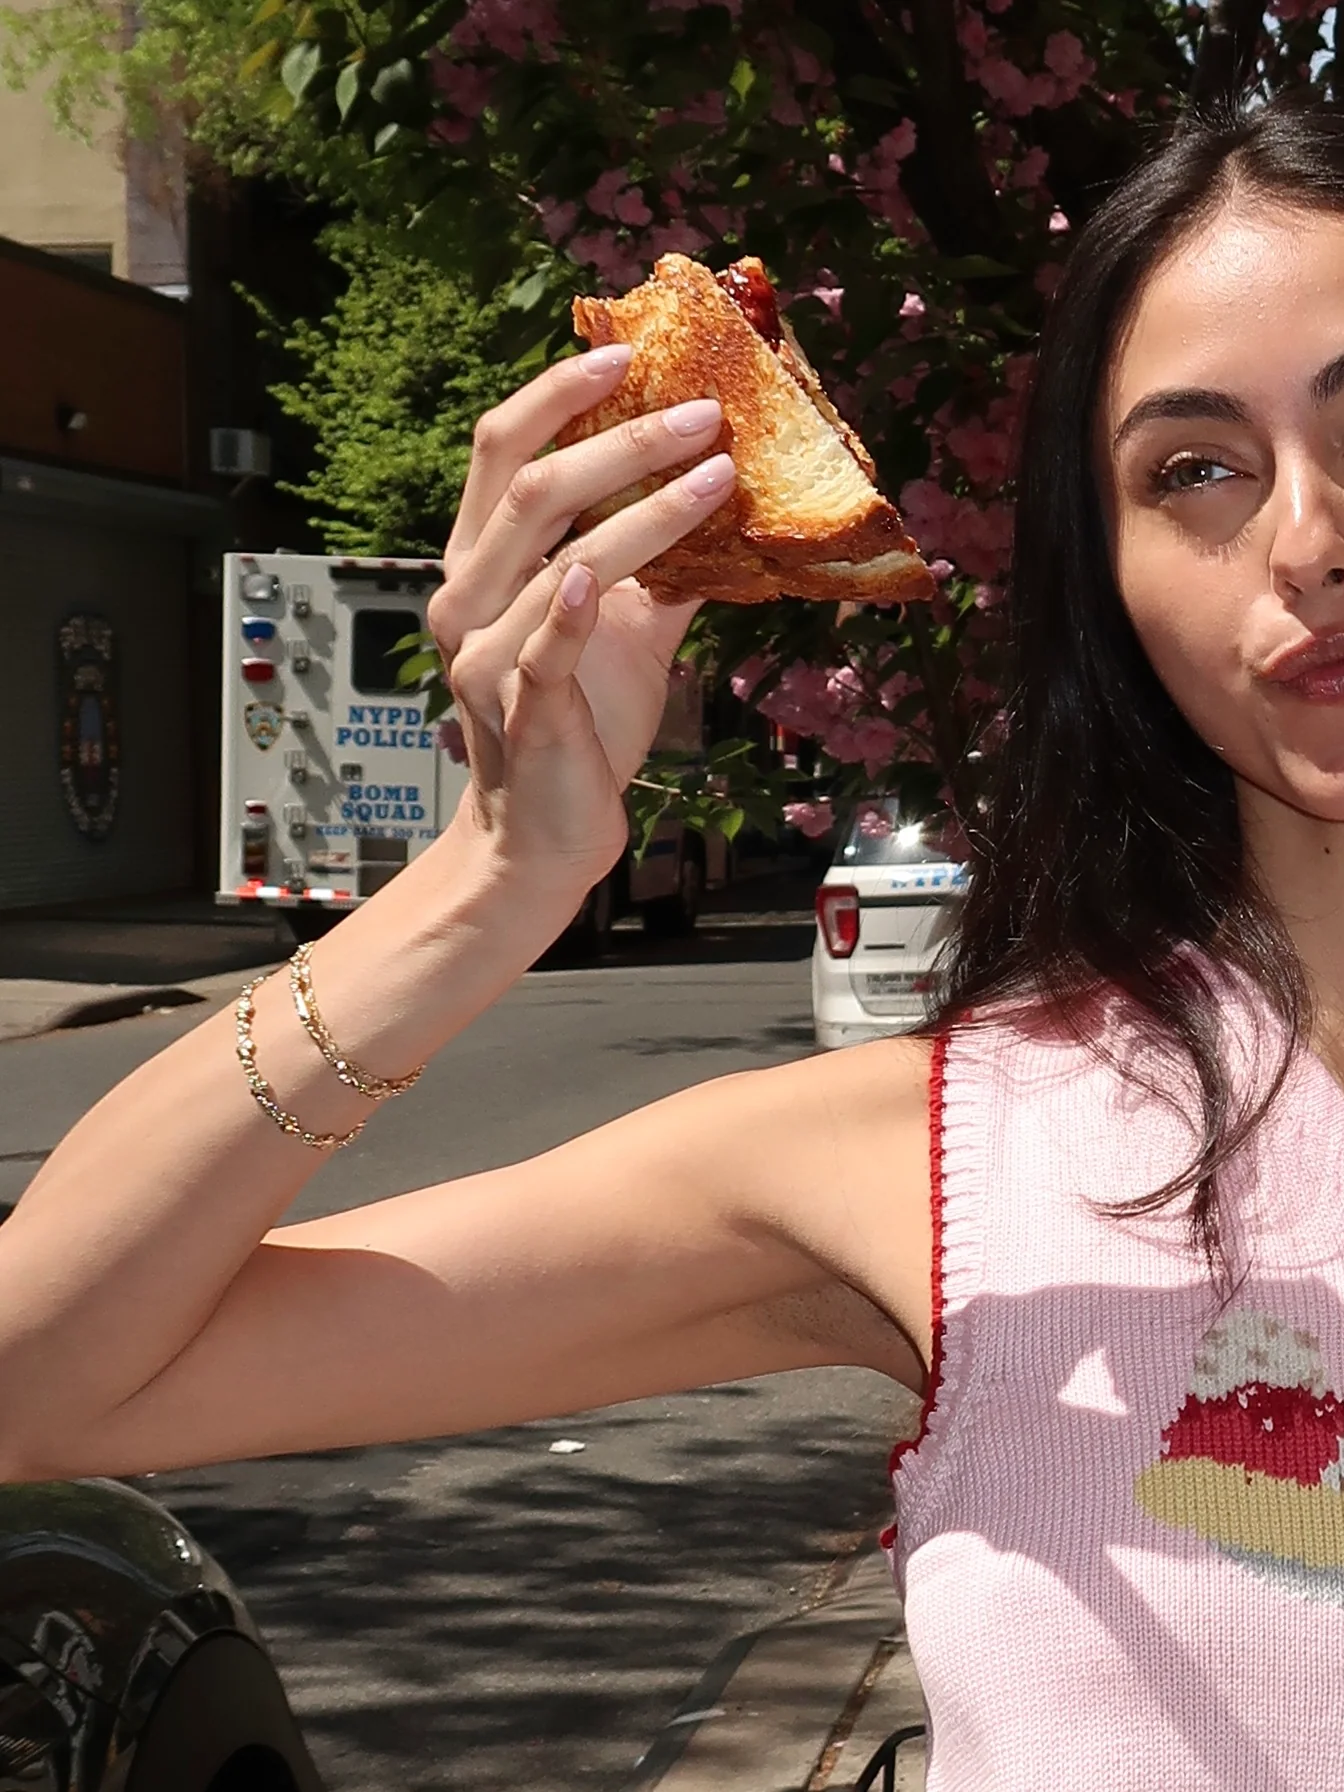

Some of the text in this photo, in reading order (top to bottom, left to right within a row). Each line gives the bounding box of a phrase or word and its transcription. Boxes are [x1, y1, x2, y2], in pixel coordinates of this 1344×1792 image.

[348, 705, 422, 726] NYPD
[336, 726, 433, 749] POLICE
[349, 783, 419, 802] BOMB
[341, 801, 425, 823] SQUAD
